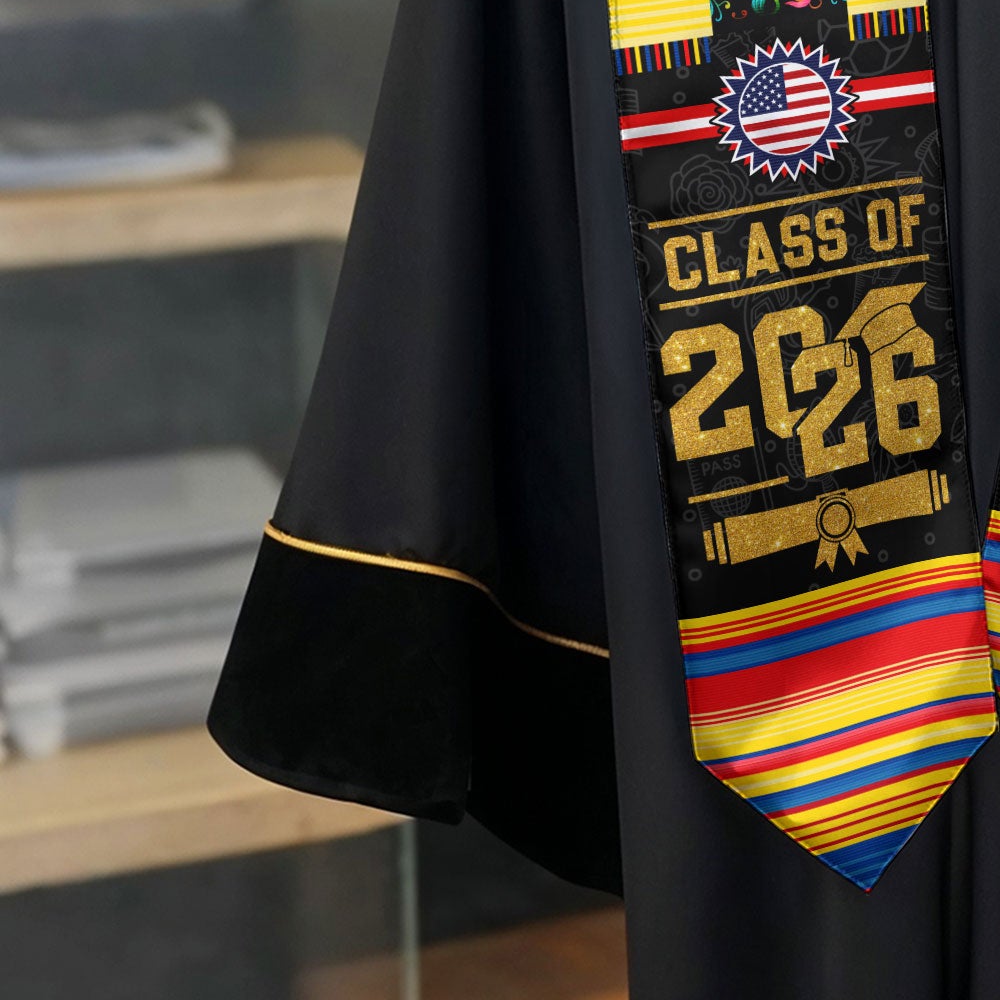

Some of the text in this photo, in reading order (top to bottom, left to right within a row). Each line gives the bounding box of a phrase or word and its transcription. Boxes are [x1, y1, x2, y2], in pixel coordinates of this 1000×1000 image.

[662, 193, 926, 292] CLASS OF
[660, 304, 942, 479] 2026
[701, 454, 742, 477] PASS
